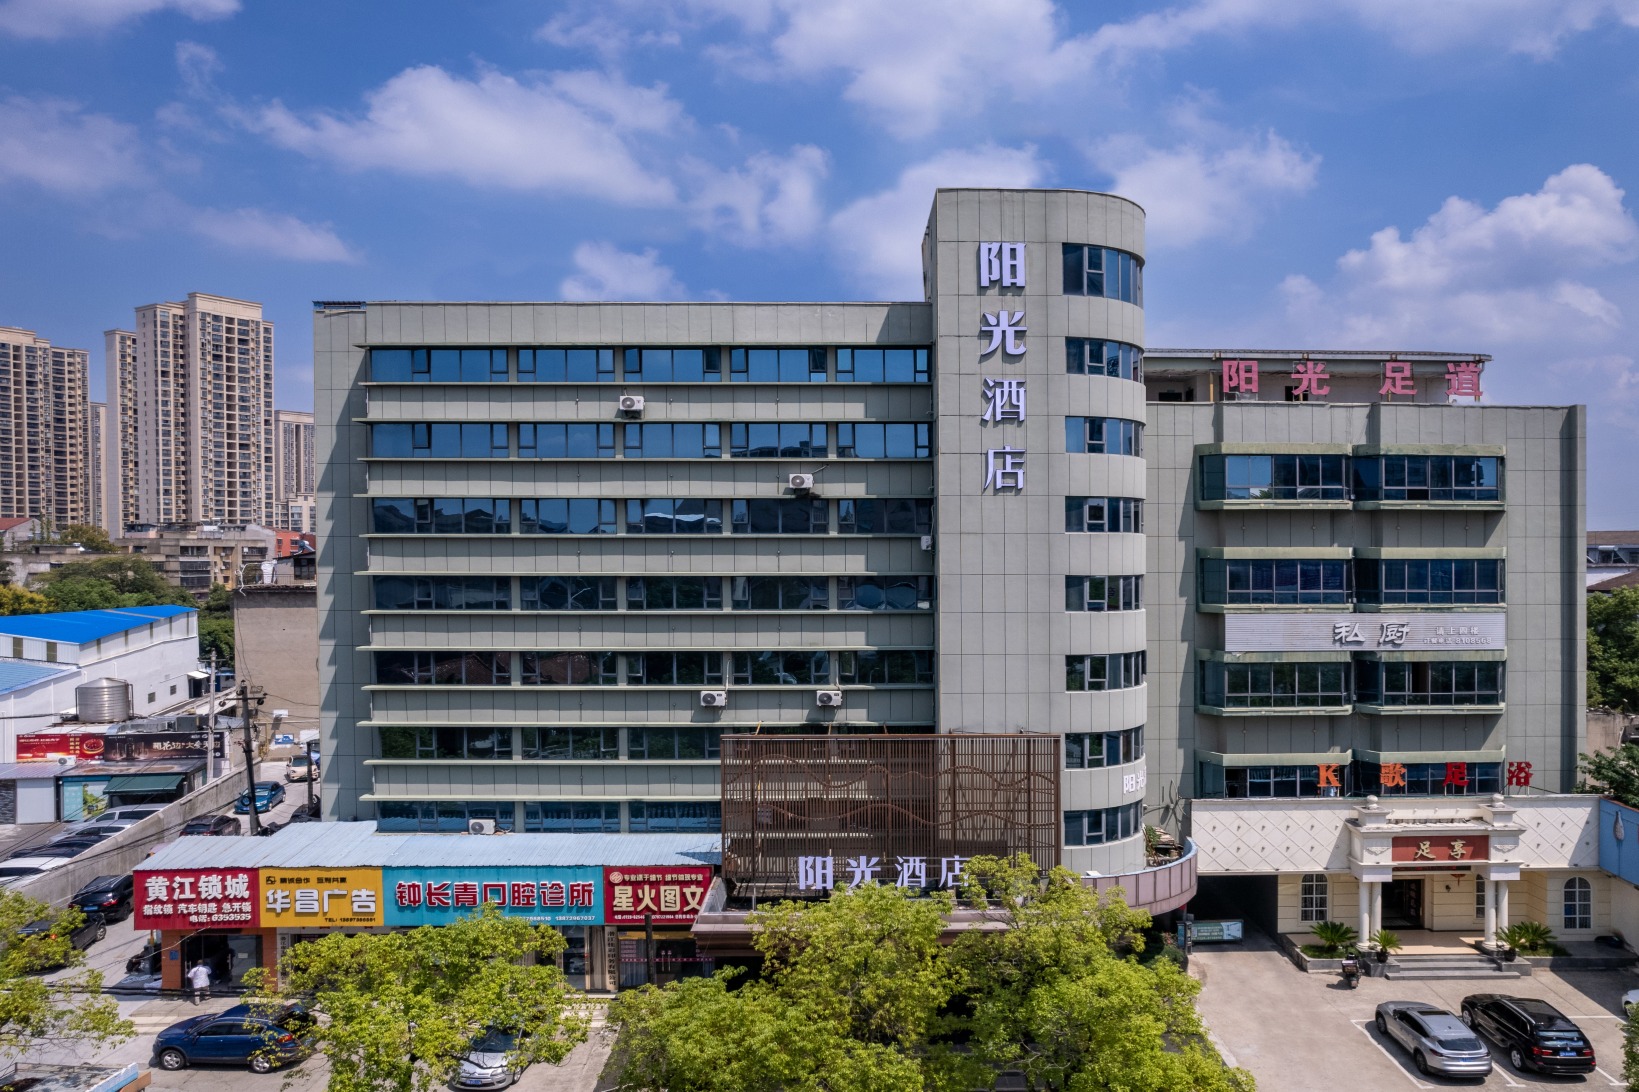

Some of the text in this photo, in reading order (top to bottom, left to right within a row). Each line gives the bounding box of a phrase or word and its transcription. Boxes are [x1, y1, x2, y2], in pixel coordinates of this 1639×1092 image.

[979, 242, 1027, 490] 阳光酒店
[1222, 360, 1483, 397] 阳光足道
[1333, 621, 1410, 645] 私厨
[1414, 839, 1466, 859] 足享
[145, 873, 250, 902] 黄江锁城
[266, 888, 376, 913] 华昌广告
[396, 881, 595, 908] 钟长青口腔诊所
[613, 884, 705, 912] 星火图文
